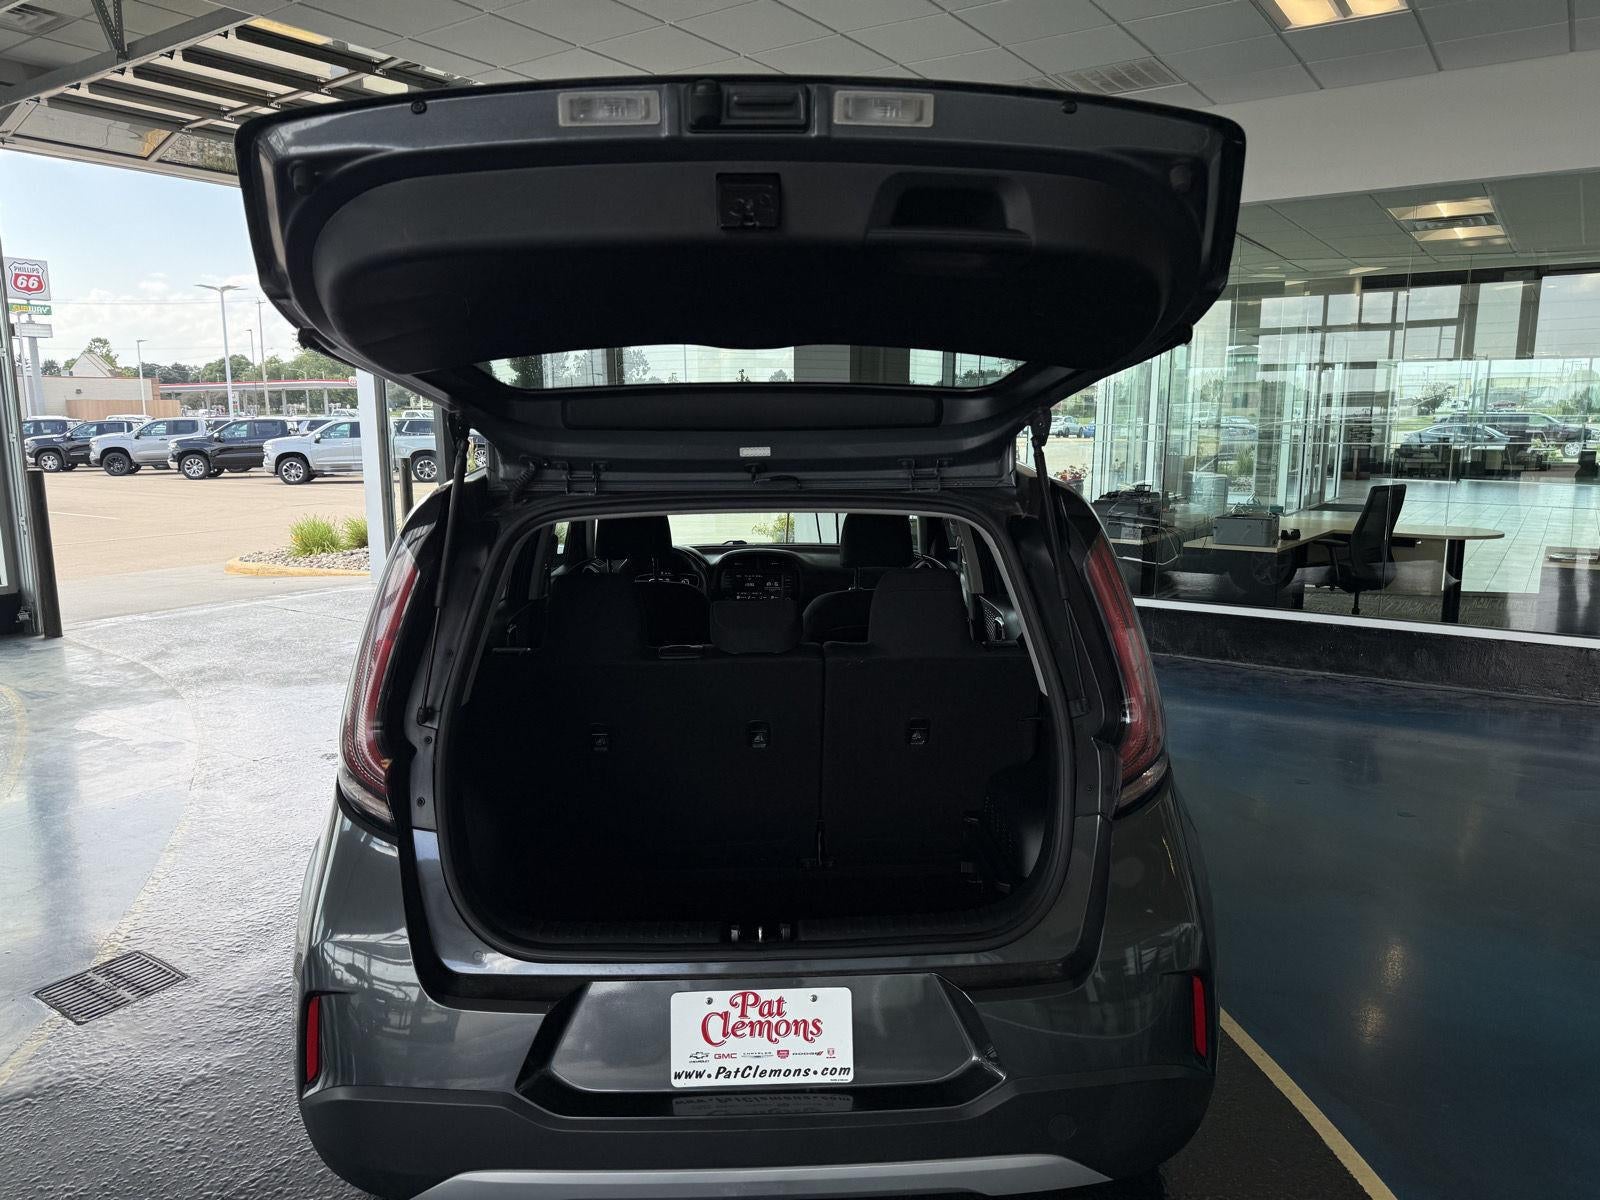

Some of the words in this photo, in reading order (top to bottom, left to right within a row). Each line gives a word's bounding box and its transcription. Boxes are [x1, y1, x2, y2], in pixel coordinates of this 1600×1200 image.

[14, 265, 40, 274] PHILLIPS
[17, 275, 39, 289] 66
[12, 304, 50, 314] SUBWAY
[729, 991, 787, 1019] Pat
[701, 1010, 823, 1047] Clemons
[673, 1065, 851, 1080] www.PatClemons.com
